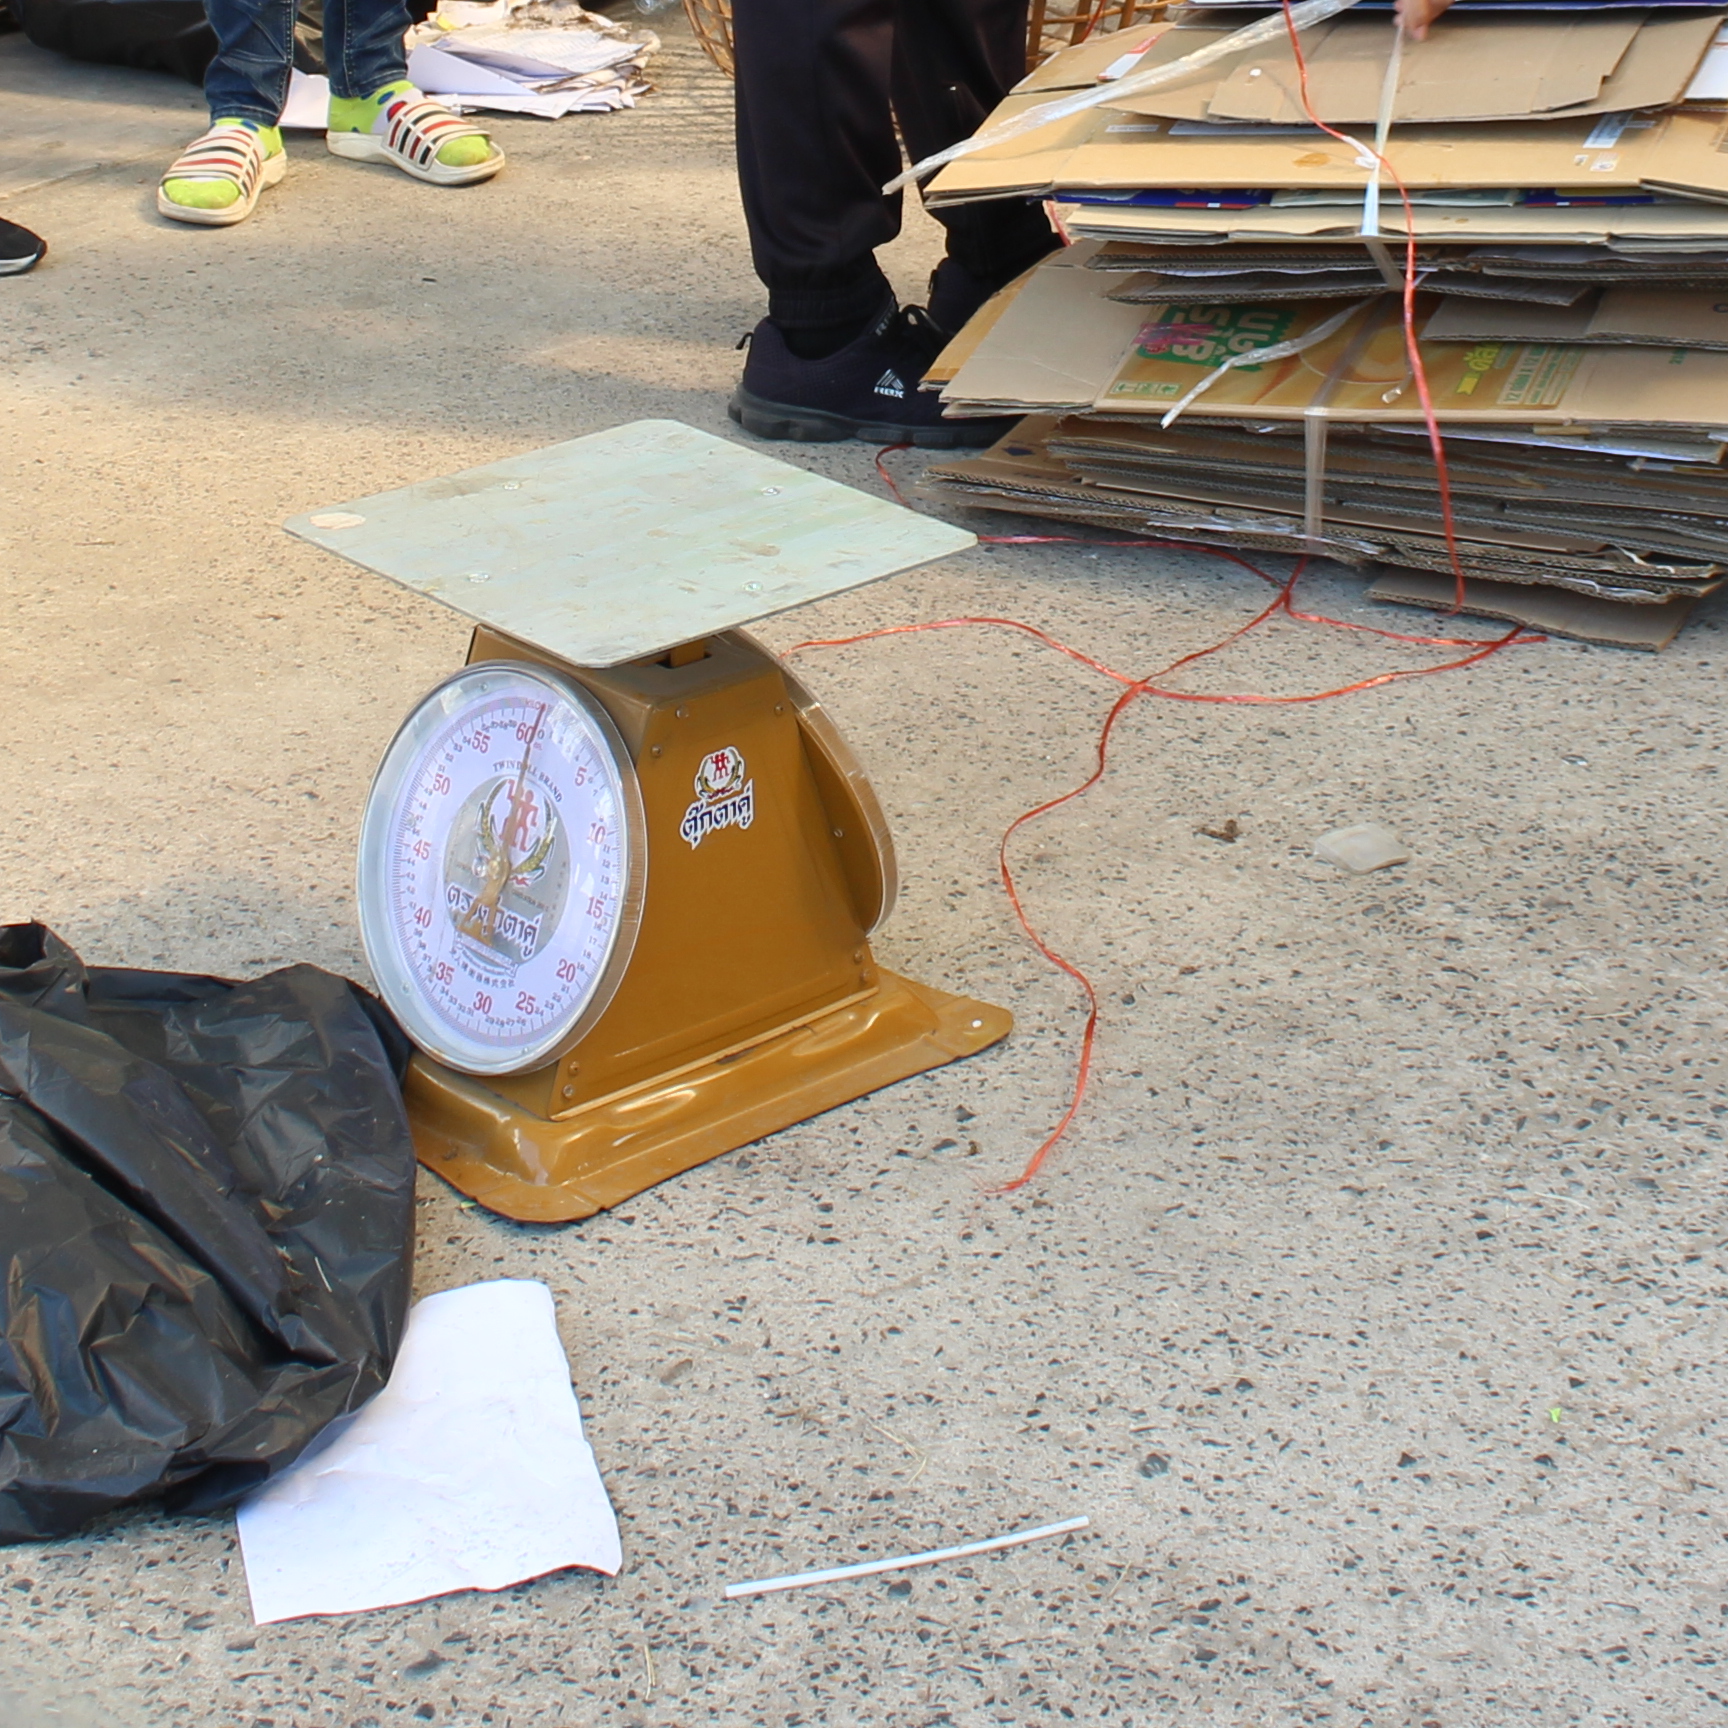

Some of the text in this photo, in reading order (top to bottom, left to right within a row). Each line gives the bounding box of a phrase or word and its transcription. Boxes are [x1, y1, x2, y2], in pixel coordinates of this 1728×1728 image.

[472, 730, 491, 754] 55
[516, 722, 535, 745] 60
[433, 773, 451, 796] 50
[574, 765, 588, 787] 5
[683, 785, 751, 843] ตุ๊กตาคู่
[589, 822, 606, 845] 10
[413, 839, 432, 861] 45
[414, 906, 431, 928] 40
[585, 896, 605, 919] 15
[435, 962, 455, 986] 35
[556, 958, 577, 983] 20
[473, 991, 493, 1015] 30
[515, 991, 537, 1015] 25
